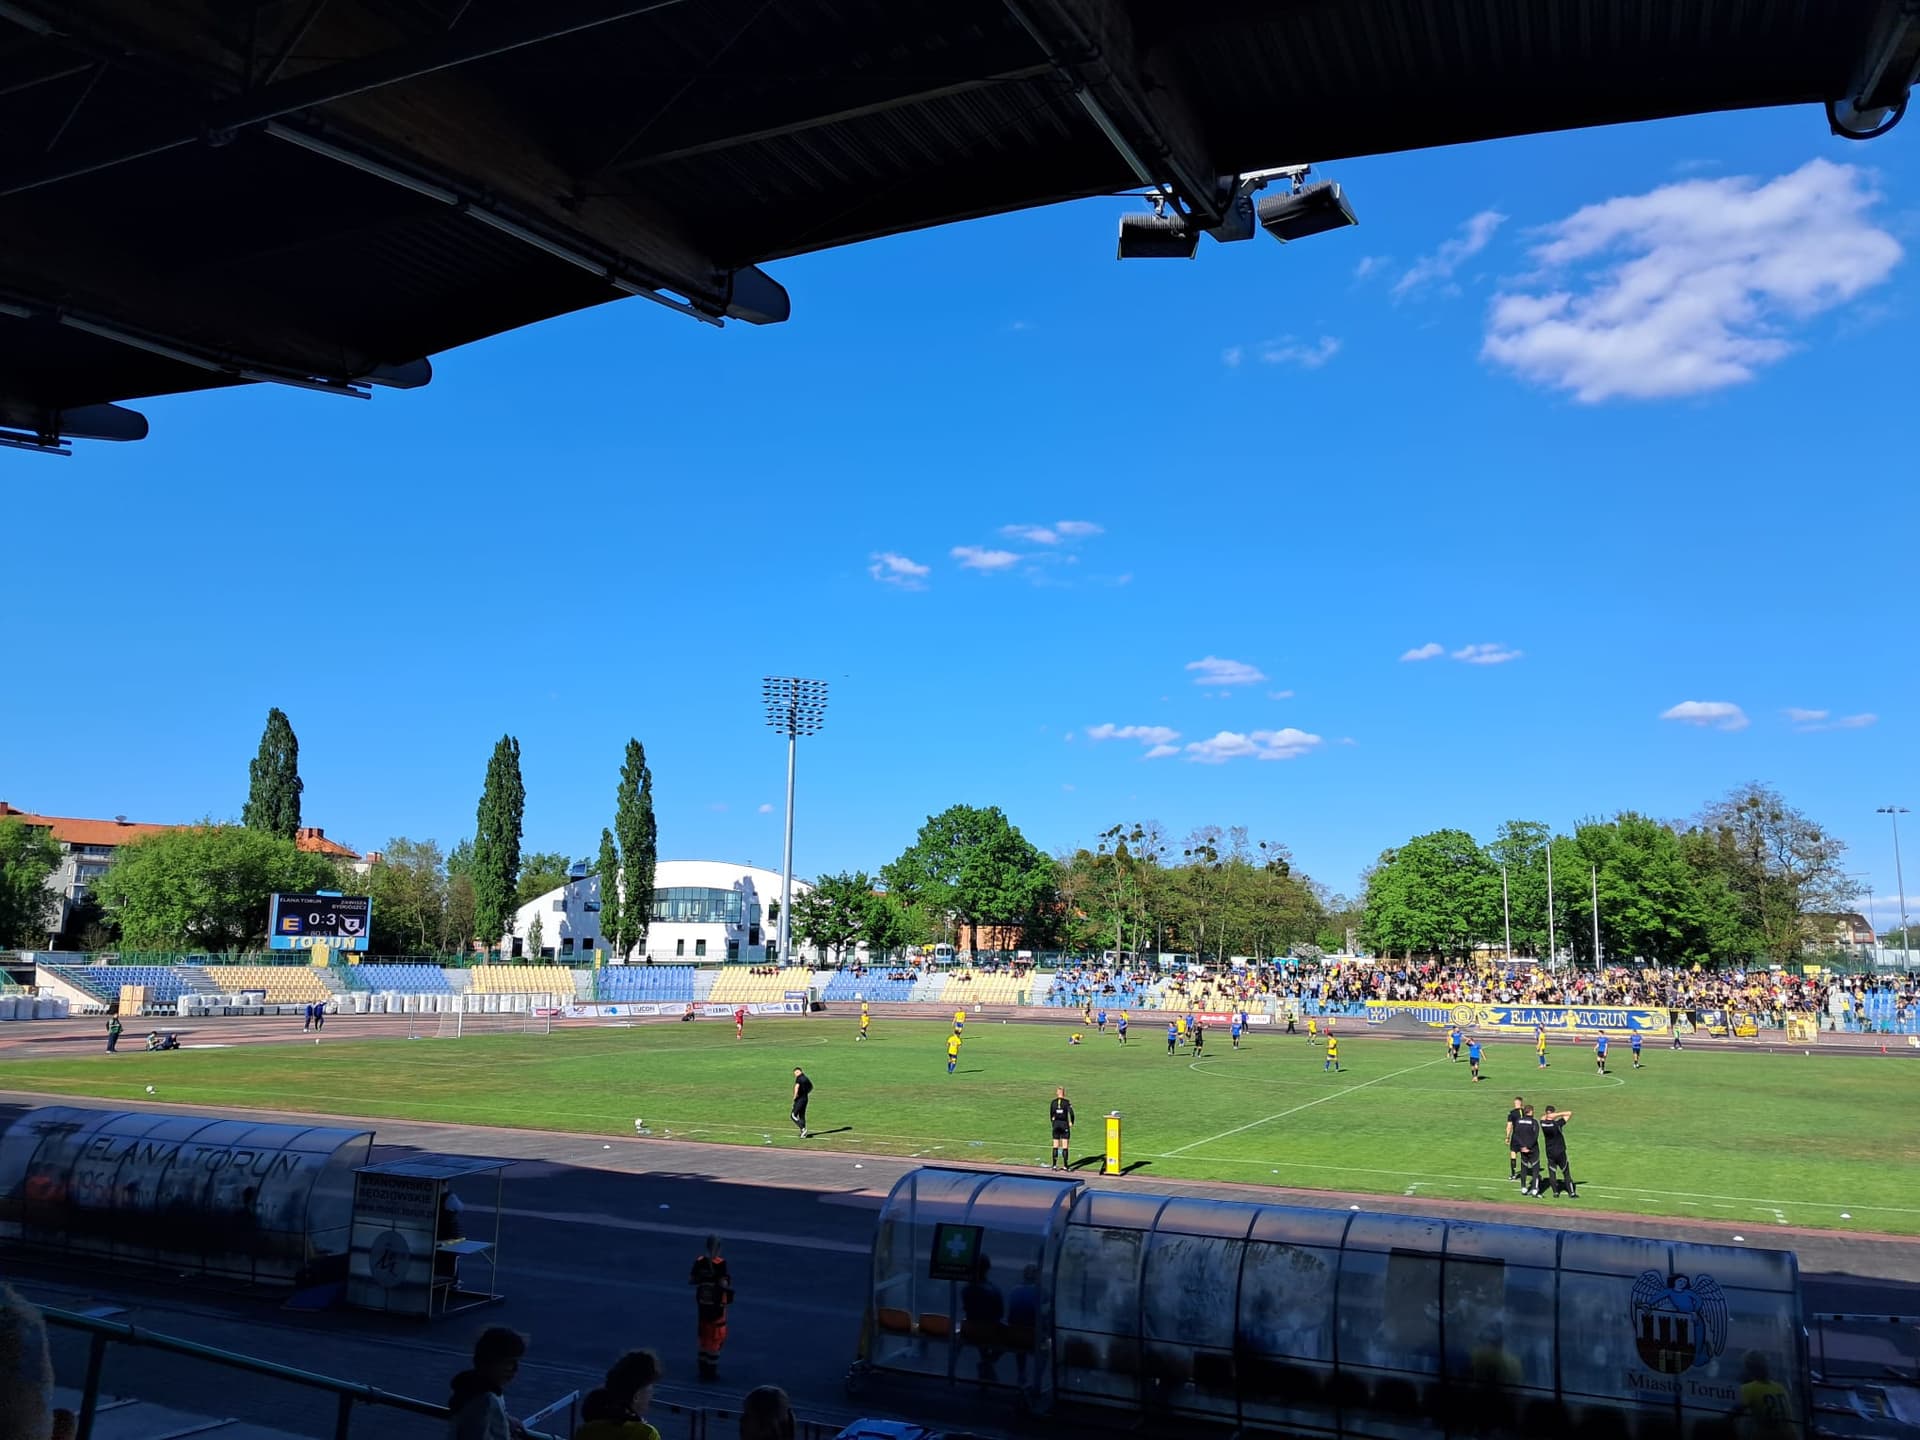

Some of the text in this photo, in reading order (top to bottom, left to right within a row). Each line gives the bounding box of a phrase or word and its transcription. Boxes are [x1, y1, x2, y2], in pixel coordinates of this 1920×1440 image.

[86, 1136, 182, 1168] ELANA
[1628, 1372, 1736, 1401] Miasto Toruń
